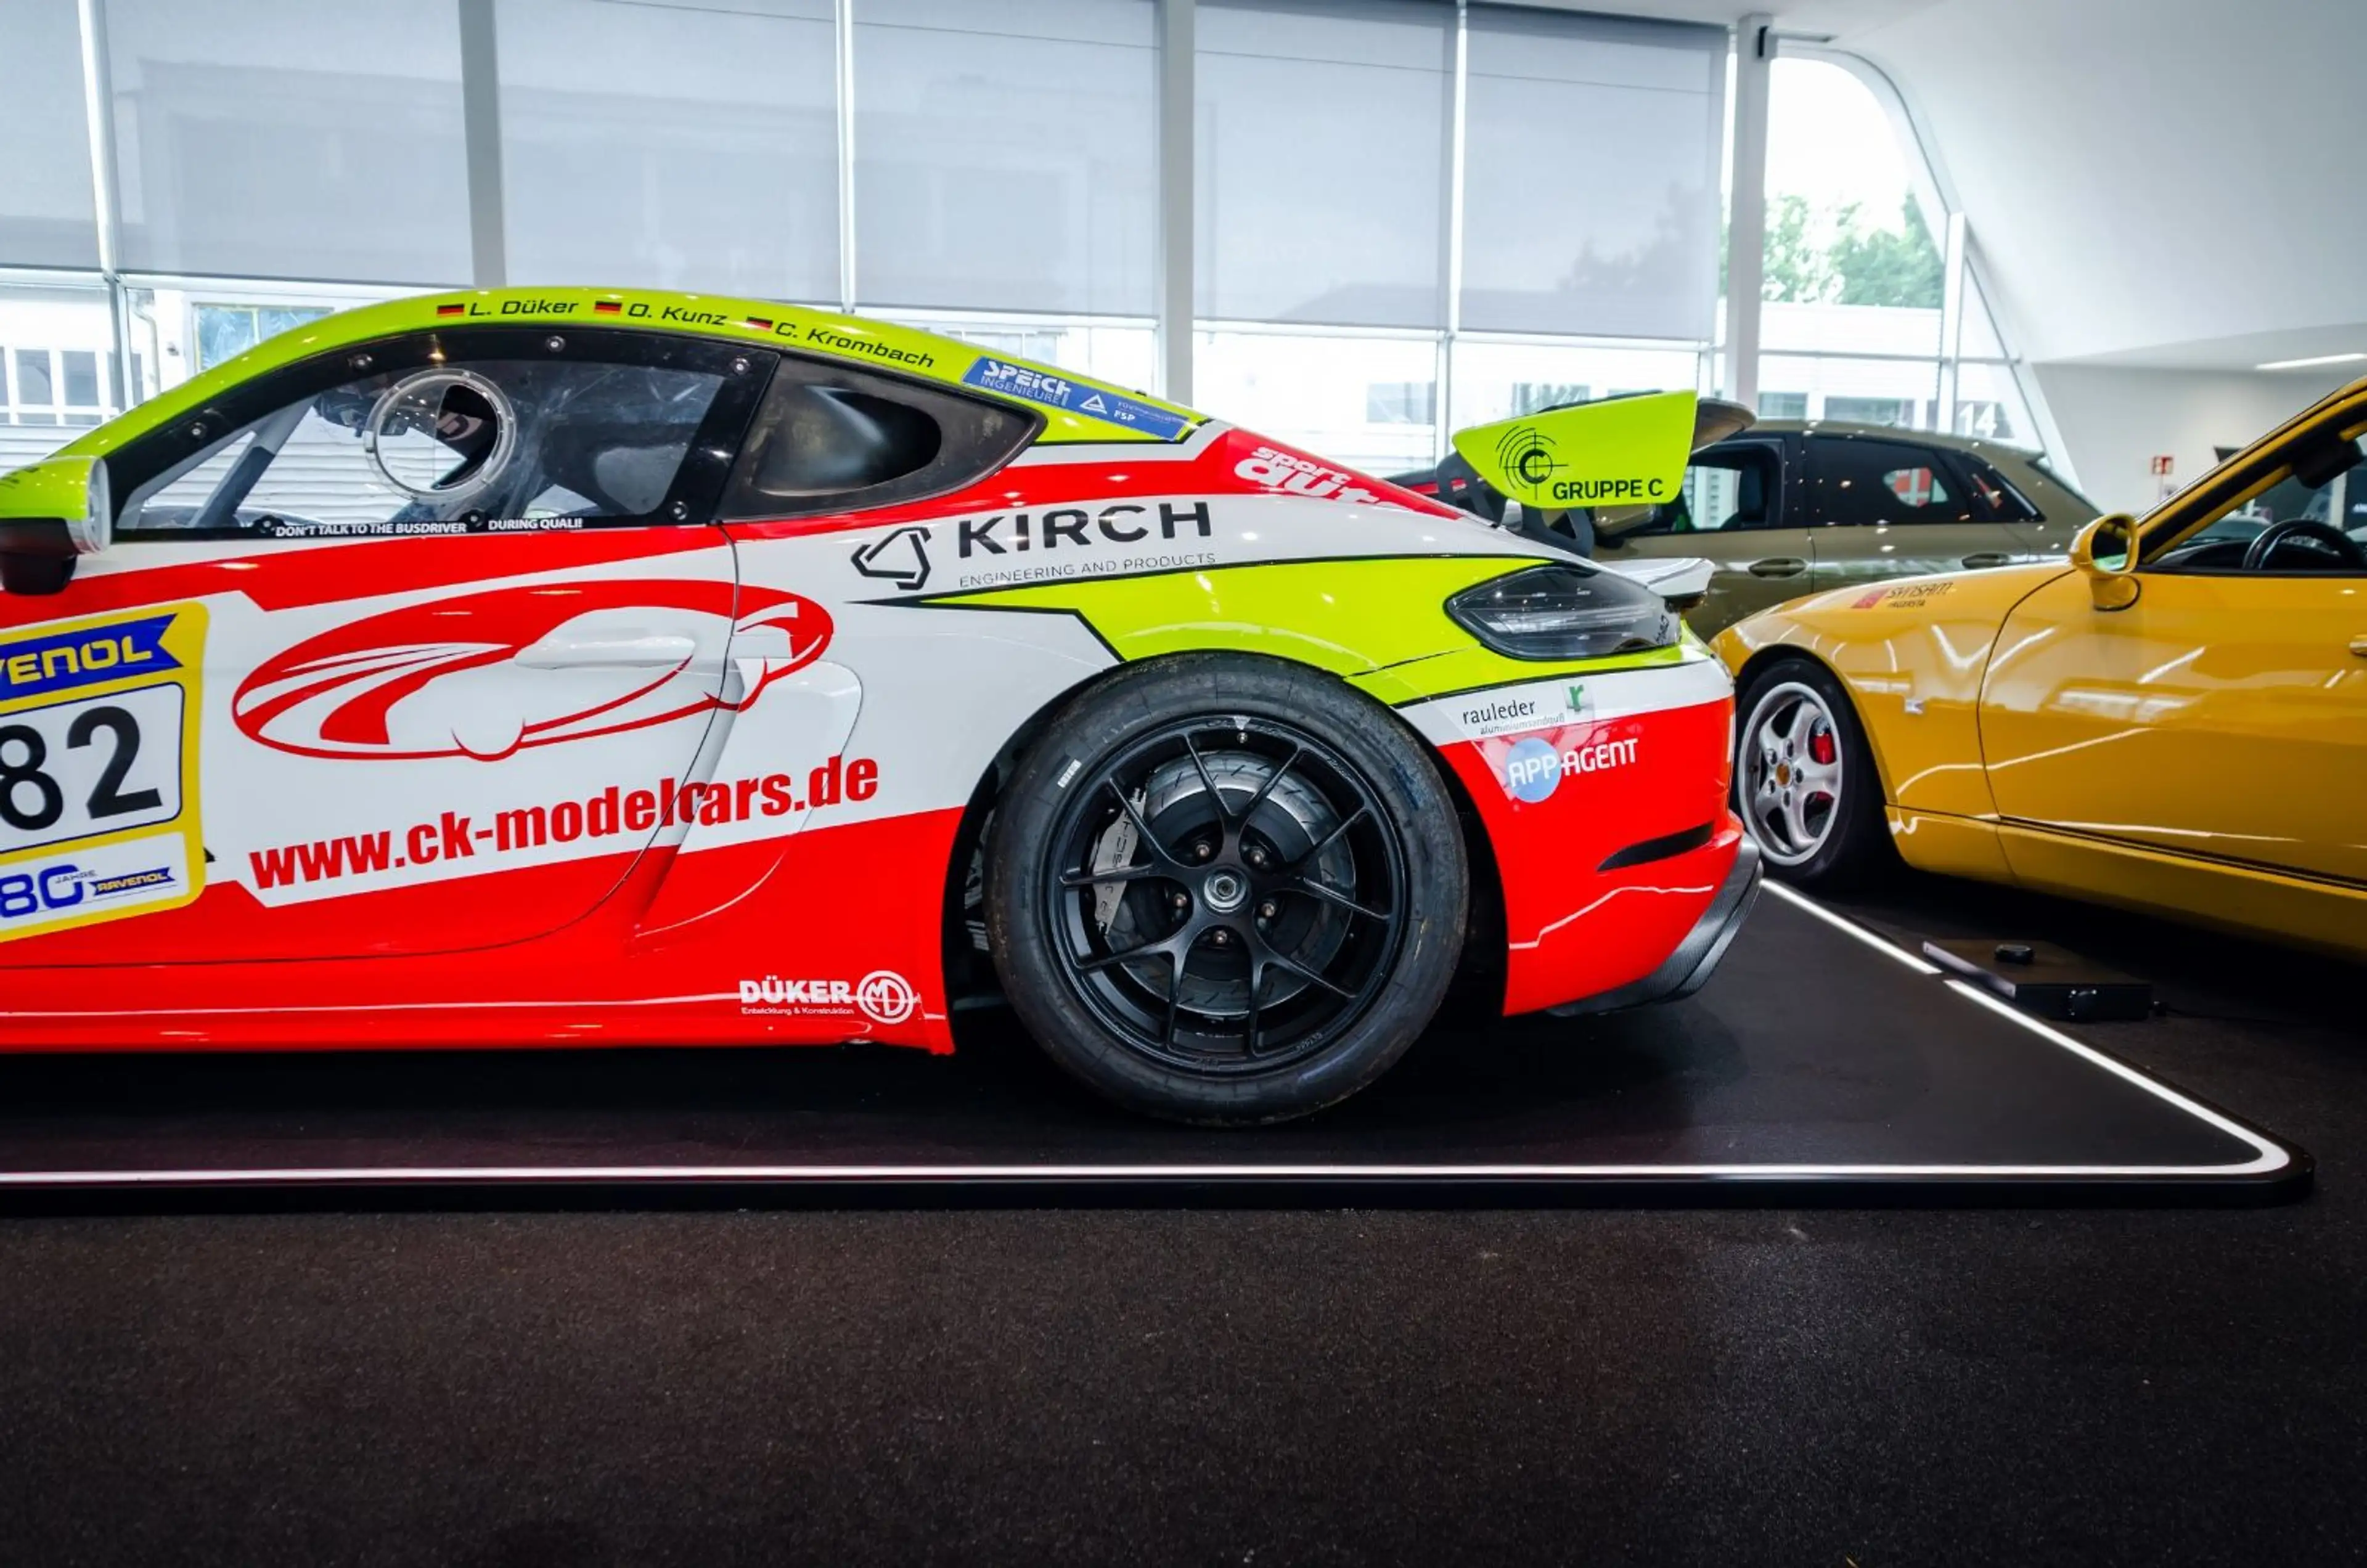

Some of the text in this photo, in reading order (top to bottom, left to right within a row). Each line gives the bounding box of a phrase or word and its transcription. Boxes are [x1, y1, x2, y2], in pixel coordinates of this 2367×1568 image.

[469, 298, 579, 317] L. Düker
[660, 306, 729, 327] Kunz
[775, 321, 935, 369] C. Krombach
[1959, 402, 1998, 436] 14
[1553, 478, 1664, 500] GRUPPE C
[276, 525, 316, 537] DON'T
[317, 525, 348, 534] TALK
[351, 524, 368, 534] TO
[370, 523, 393, 533] THE
[395, 523, 467, 534] BUSDRIVER
[488, 519, 538, 530] DURING
[959, 501, 1212, 558] KIRCH
[959, 553, 1216, 588] ENGINEERING AND PRODUCTS
[0, 636, 153, 685] ENOL
[1463, 700, 1535, 724] rauleder
[249, 754, 879, 889] www.ck-modelcars.de
[96, 873, 167, 891] RAVENOL
[740, 975, 853, 1004] DÜKER
